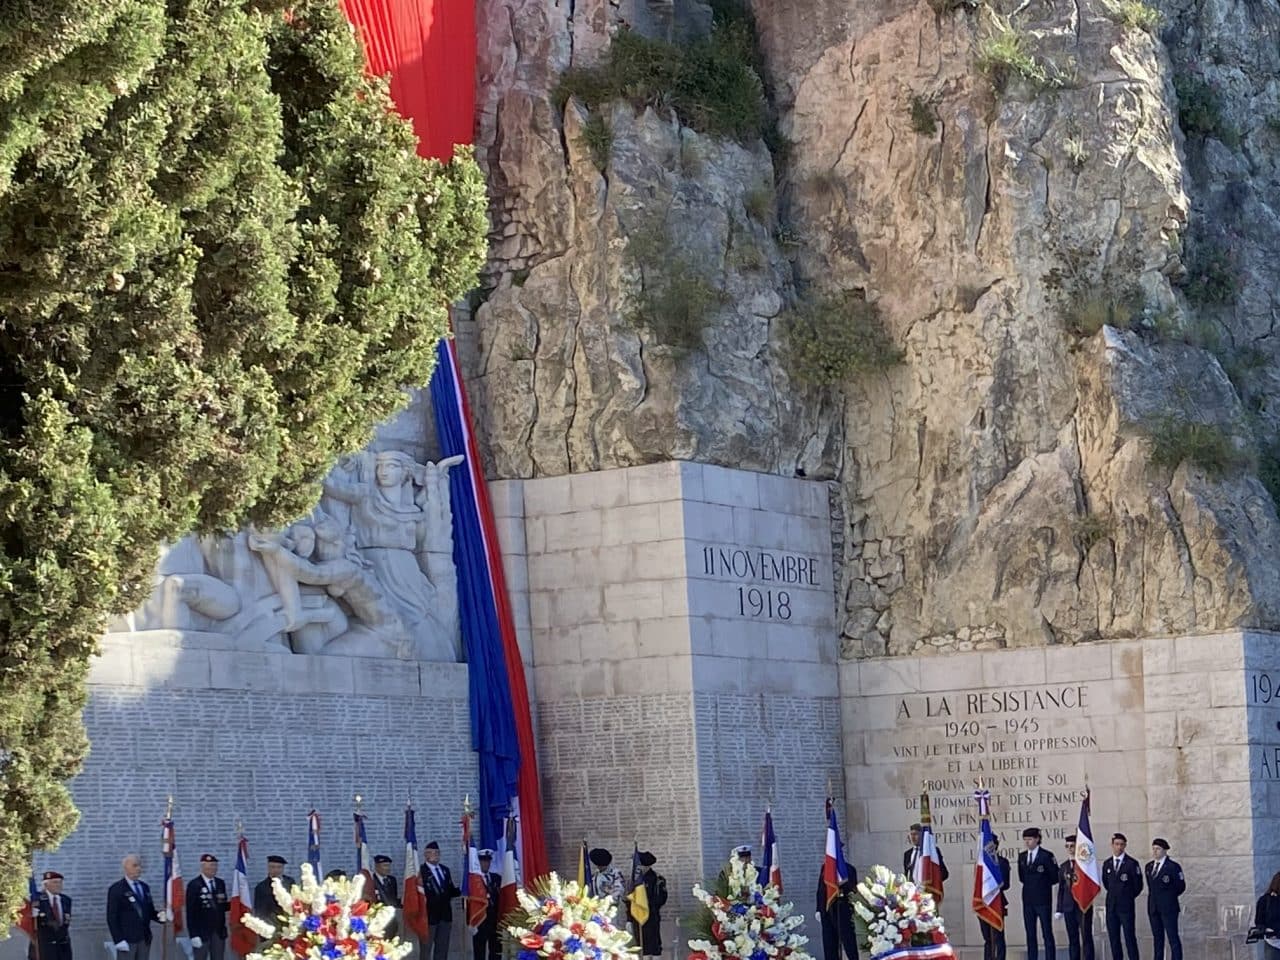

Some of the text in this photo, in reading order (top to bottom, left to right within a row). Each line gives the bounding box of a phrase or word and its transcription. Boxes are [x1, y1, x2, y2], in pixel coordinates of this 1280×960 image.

[703, 546, 820, 585] 11 NOVEMBRE
[737, 586, 792, 620] 1918
[896, 686, 1089, 720] A LA RESISTANCE
[945, 720, 980, 738] 1940
[1005, 717, 1040, 735] 1945
[893, 745, 919, 757] VINT
[926, 744, 940, 756] LE
[948, 742, 985, 755] TEMPS
[992, 740, 1006, 753] DE
[948, 761, 962, 773] ET
[969, 760, 984, 772] LA
[1003, 775, 1039, 788] NOTRE
[1047, 773, 1069, 786] SOL
[905, 799, 919, 810] DE
[1010, 793, 1032, 805] DES
[1039, 791, 1087, 804] FEMMES
[1041, 809, 1069, 822] VIVE
